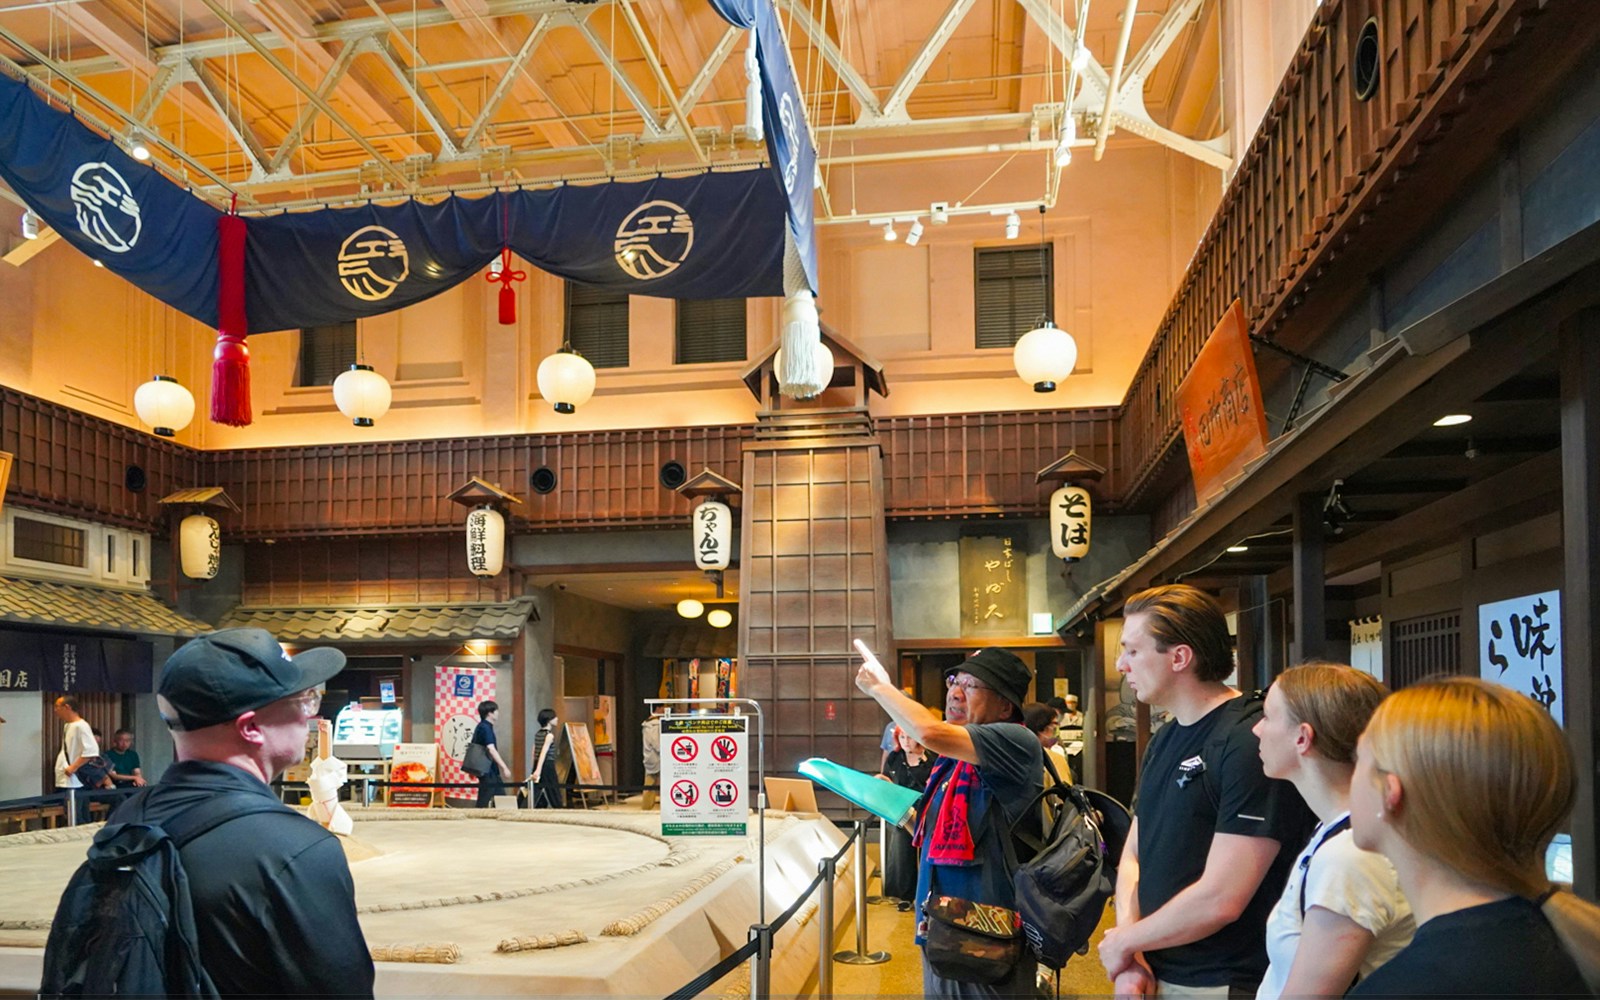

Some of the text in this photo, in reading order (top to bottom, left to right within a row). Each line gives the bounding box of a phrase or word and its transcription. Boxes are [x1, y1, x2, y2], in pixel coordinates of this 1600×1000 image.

[469, 512, 488, 571] 海鮮料理
[698, 506, 720, 565] ちゃんこ
[1058, 493, 1089, 548] そば
